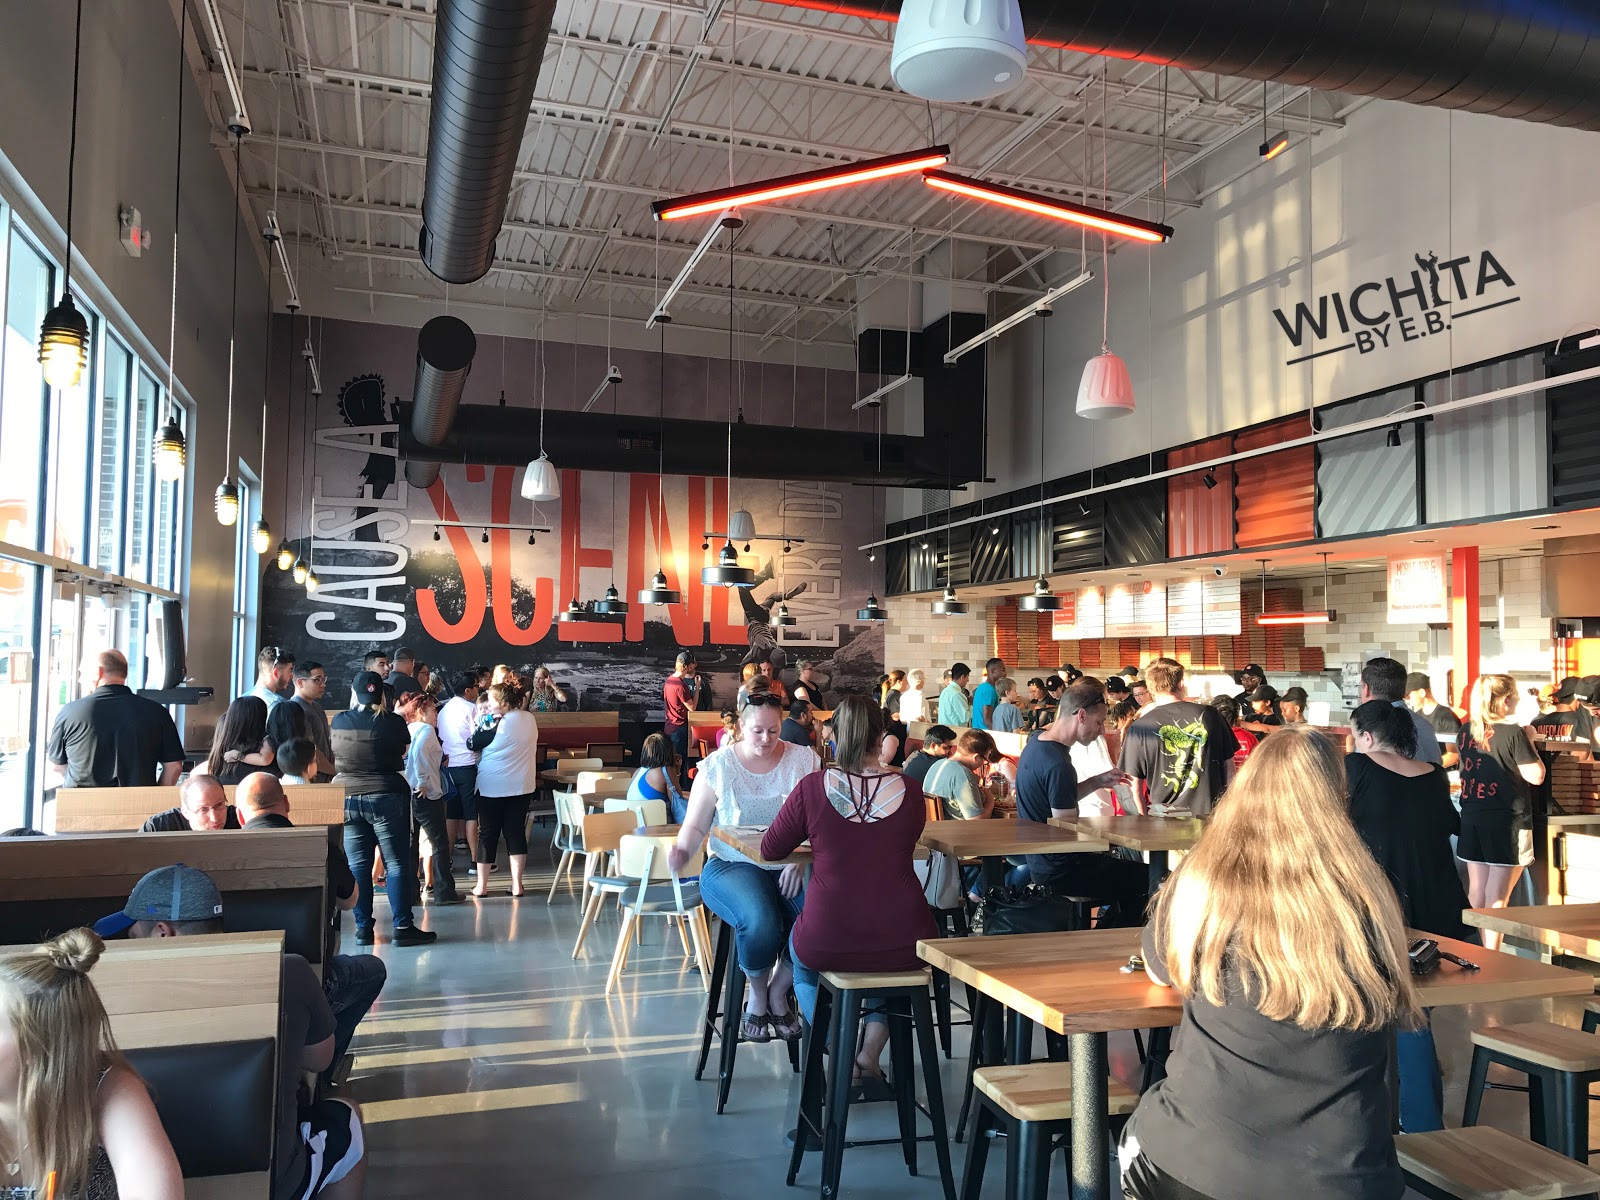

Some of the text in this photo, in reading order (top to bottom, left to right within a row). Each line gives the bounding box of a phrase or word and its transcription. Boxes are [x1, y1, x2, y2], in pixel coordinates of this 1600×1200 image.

[1272, 250, 1516, 347] WICHITA
[1355, 310, 1452, 354] BY E.B.
[305, 423, 409, 642] CAUSE A
[777, 480, 843, 648] EVERY DA
[1465, 757, 1482, 772] OF
